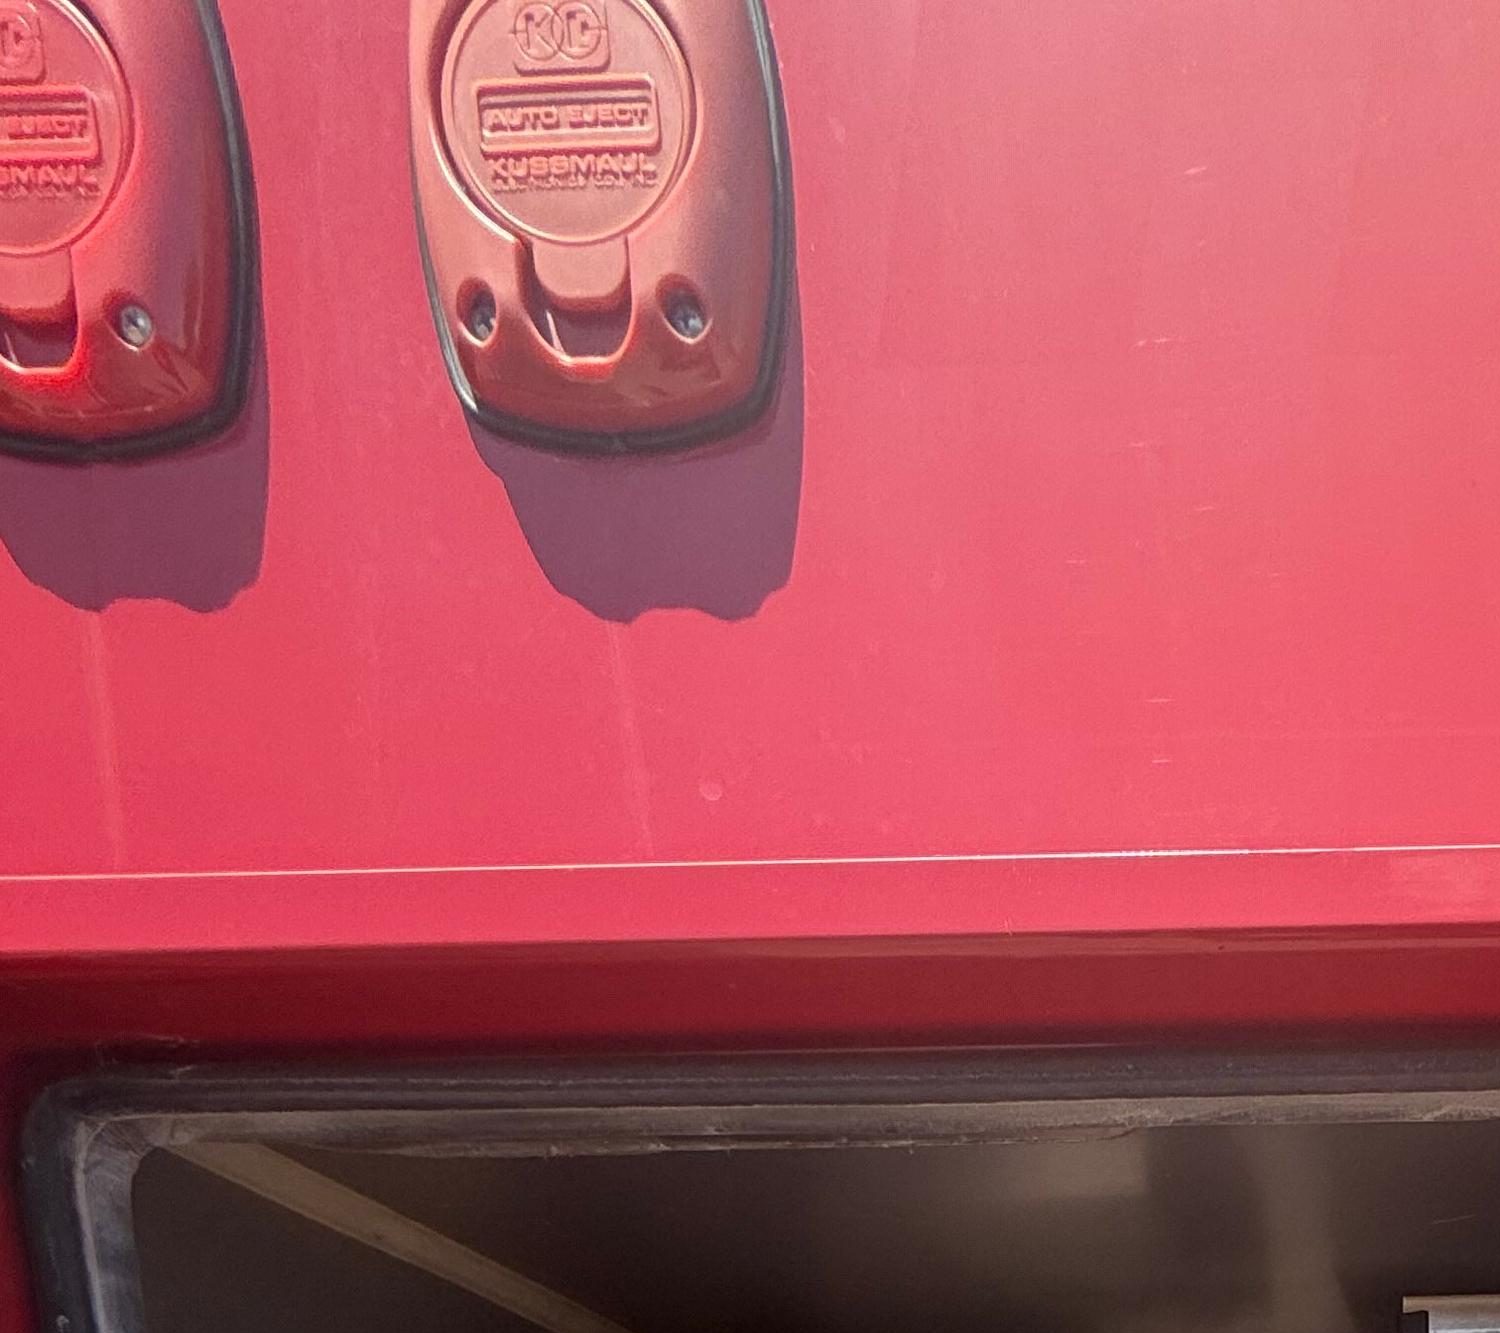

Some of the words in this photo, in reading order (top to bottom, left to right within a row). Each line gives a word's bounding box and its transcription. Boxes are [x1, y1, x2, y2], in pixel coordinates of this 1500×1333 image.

[488, 106, 560, 132] AUTO
[567, 103, 650, 130] EJECT
[489, 154, 658, 181] KUSSMAUL
